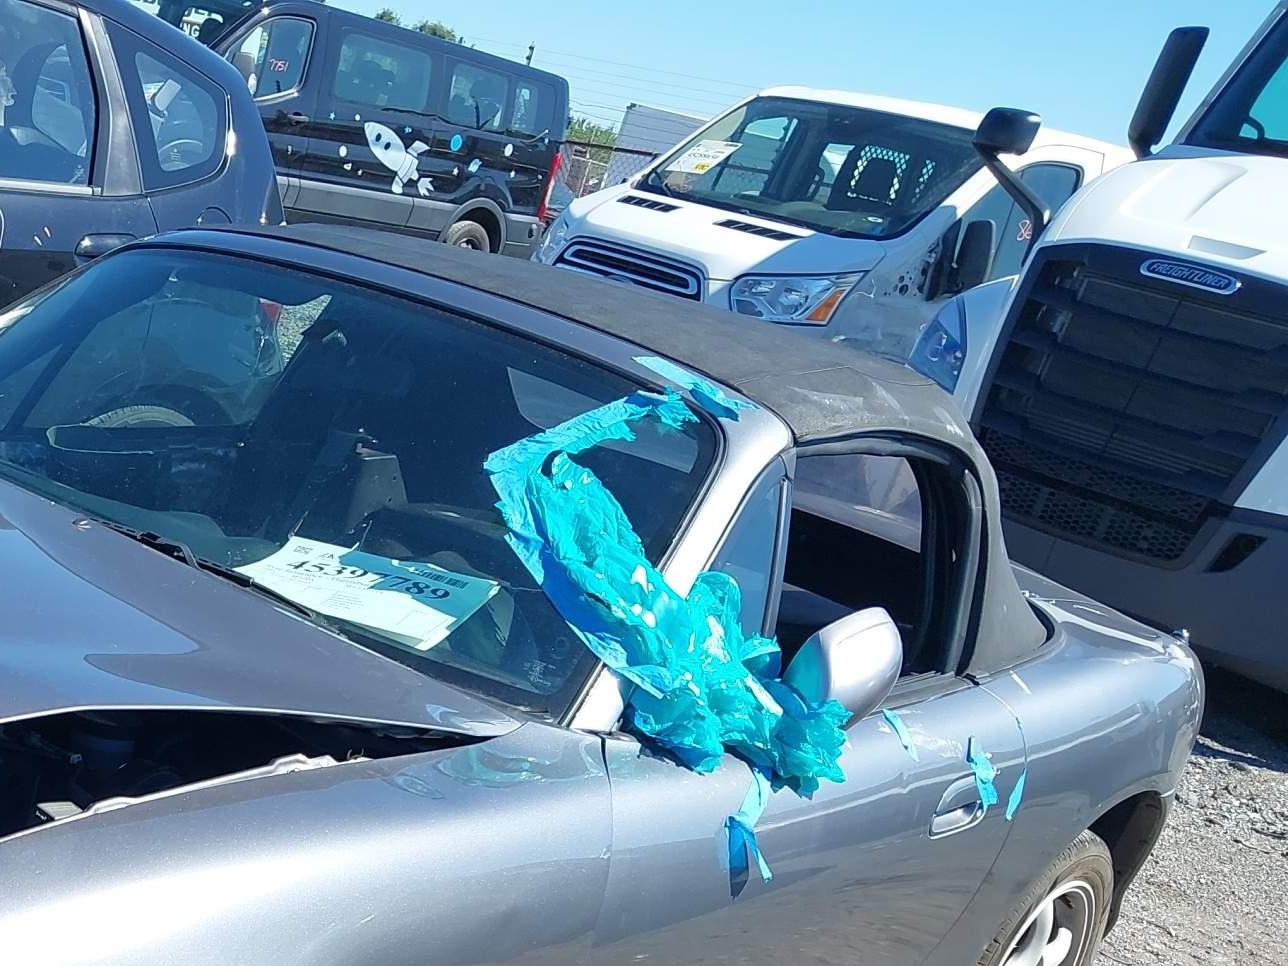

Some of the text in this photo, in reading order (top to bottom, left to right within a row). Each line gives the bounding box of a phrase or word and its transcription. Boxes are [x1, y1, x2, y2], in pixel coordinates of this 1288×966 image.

[269, 58, 289, 72] 7751
[1149, 262, 1230, 290] FREIGHTLINER
[286, 559, 452, 601] 45397789
